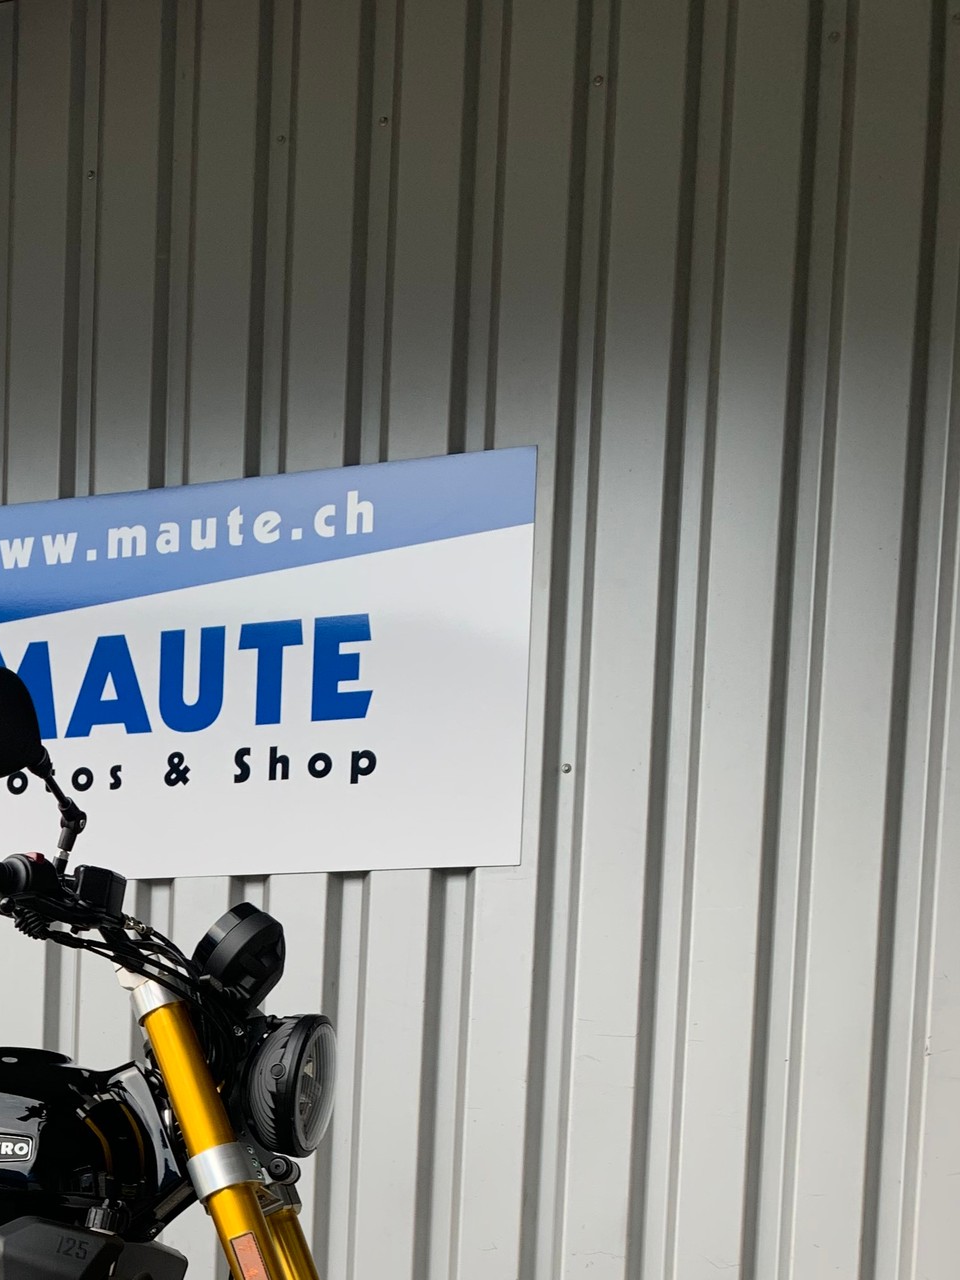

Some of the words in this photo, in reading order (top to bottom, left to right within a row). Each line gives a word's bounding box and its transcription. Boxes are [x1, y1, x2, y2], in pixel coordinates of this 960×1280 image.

[163, 751, 191, 786] &
[233, 745, 377, 785] Shop
[56, 1236, 89, 1260] 125
